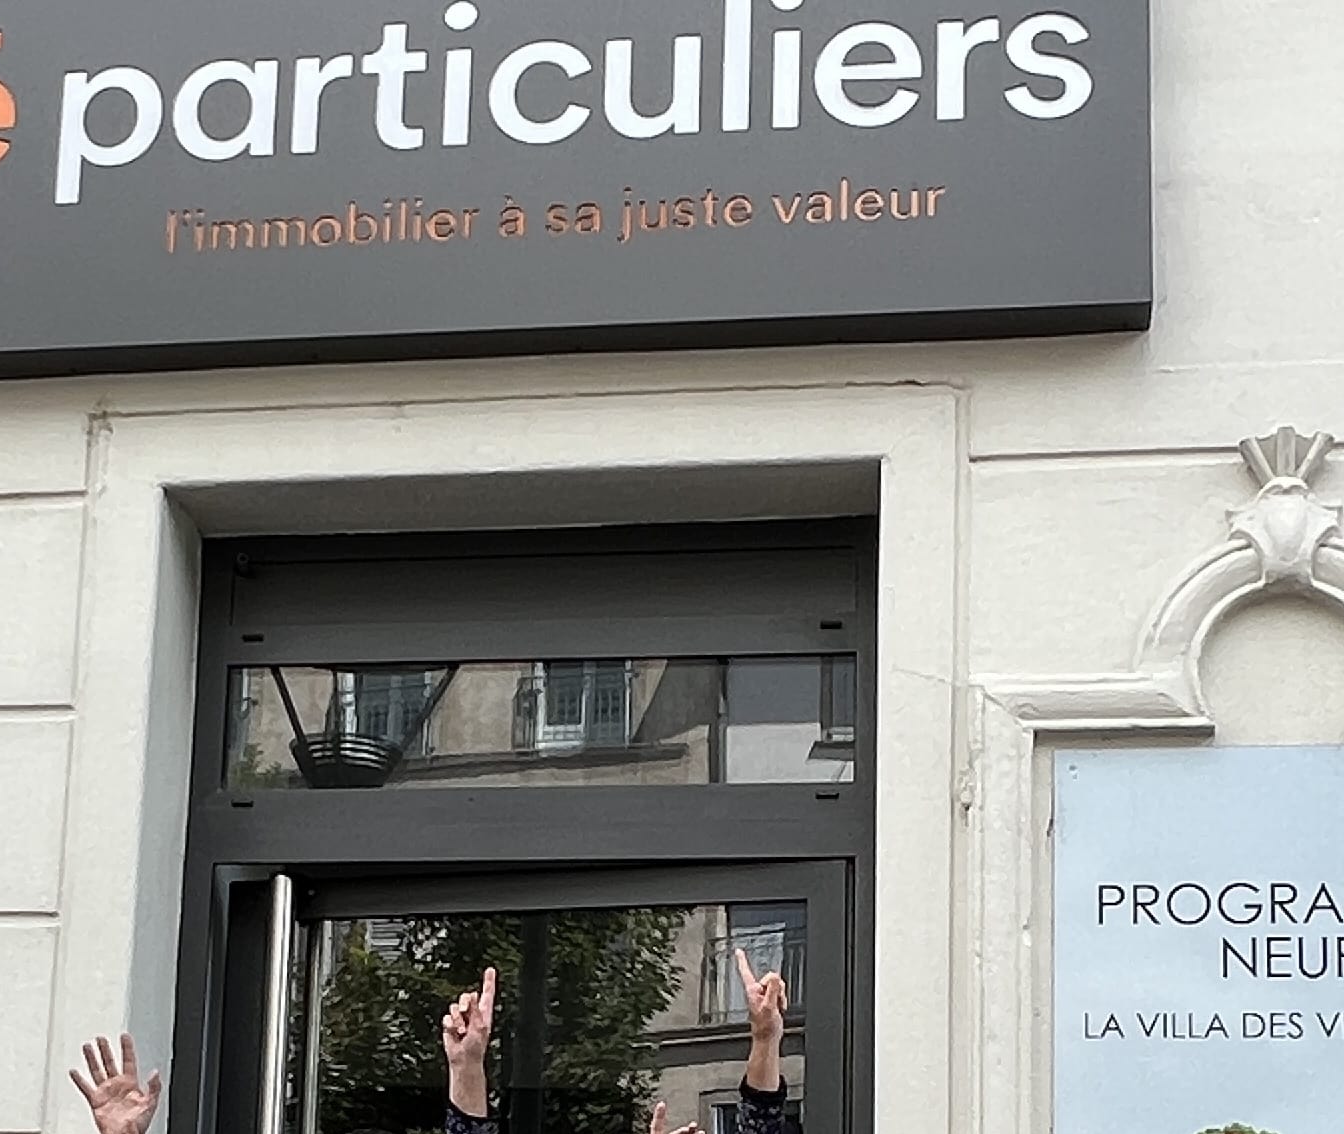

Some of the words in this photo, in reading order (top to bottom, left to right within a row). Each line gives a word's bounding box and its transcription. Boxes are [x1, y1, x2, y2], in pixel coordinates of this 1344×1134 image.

[55, 0, 1093, 204] particuliers
[166, 201, 478, 252] l'immobilier
[500, 204, 526, 236] à
[545, 203, 603, 234] sa
[621, 190, 753, 242] juste
[773, 180, 944, 224] valeur
[1085, 1013, 1124, 1039] LA
[1137, 1013, 1229, 1038] VILLA
[1243, 1013, 1303, 1039] DES
